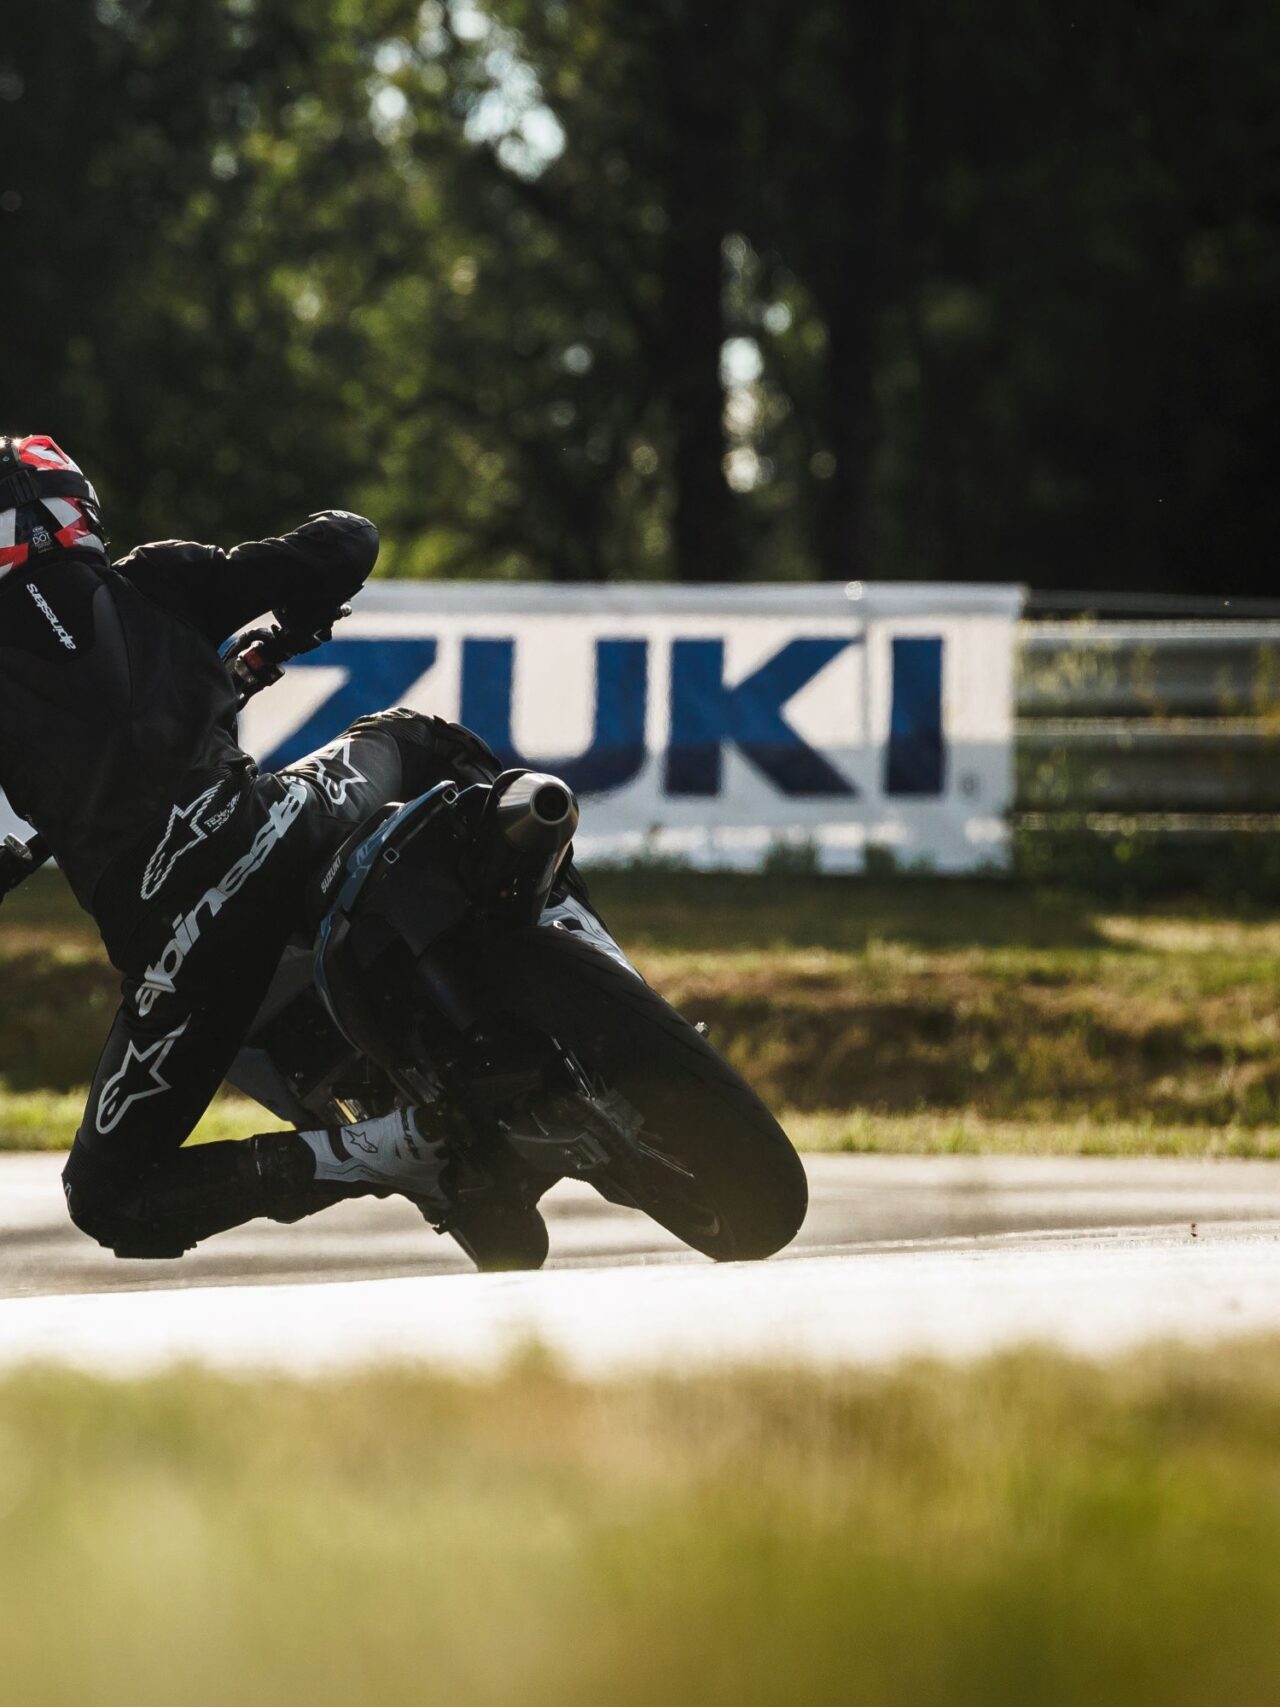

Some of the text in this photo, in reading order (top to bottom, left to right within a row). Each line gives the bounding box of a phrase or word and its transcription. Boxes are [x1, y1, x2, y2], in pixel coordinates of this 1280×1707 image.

[32, 532, 51, 545] DOT
[26, 583, 77, 651] alpinestars
[135, 775, 308, 1017] alpinesta
[320, 855, 342, 894] SUZUKI
